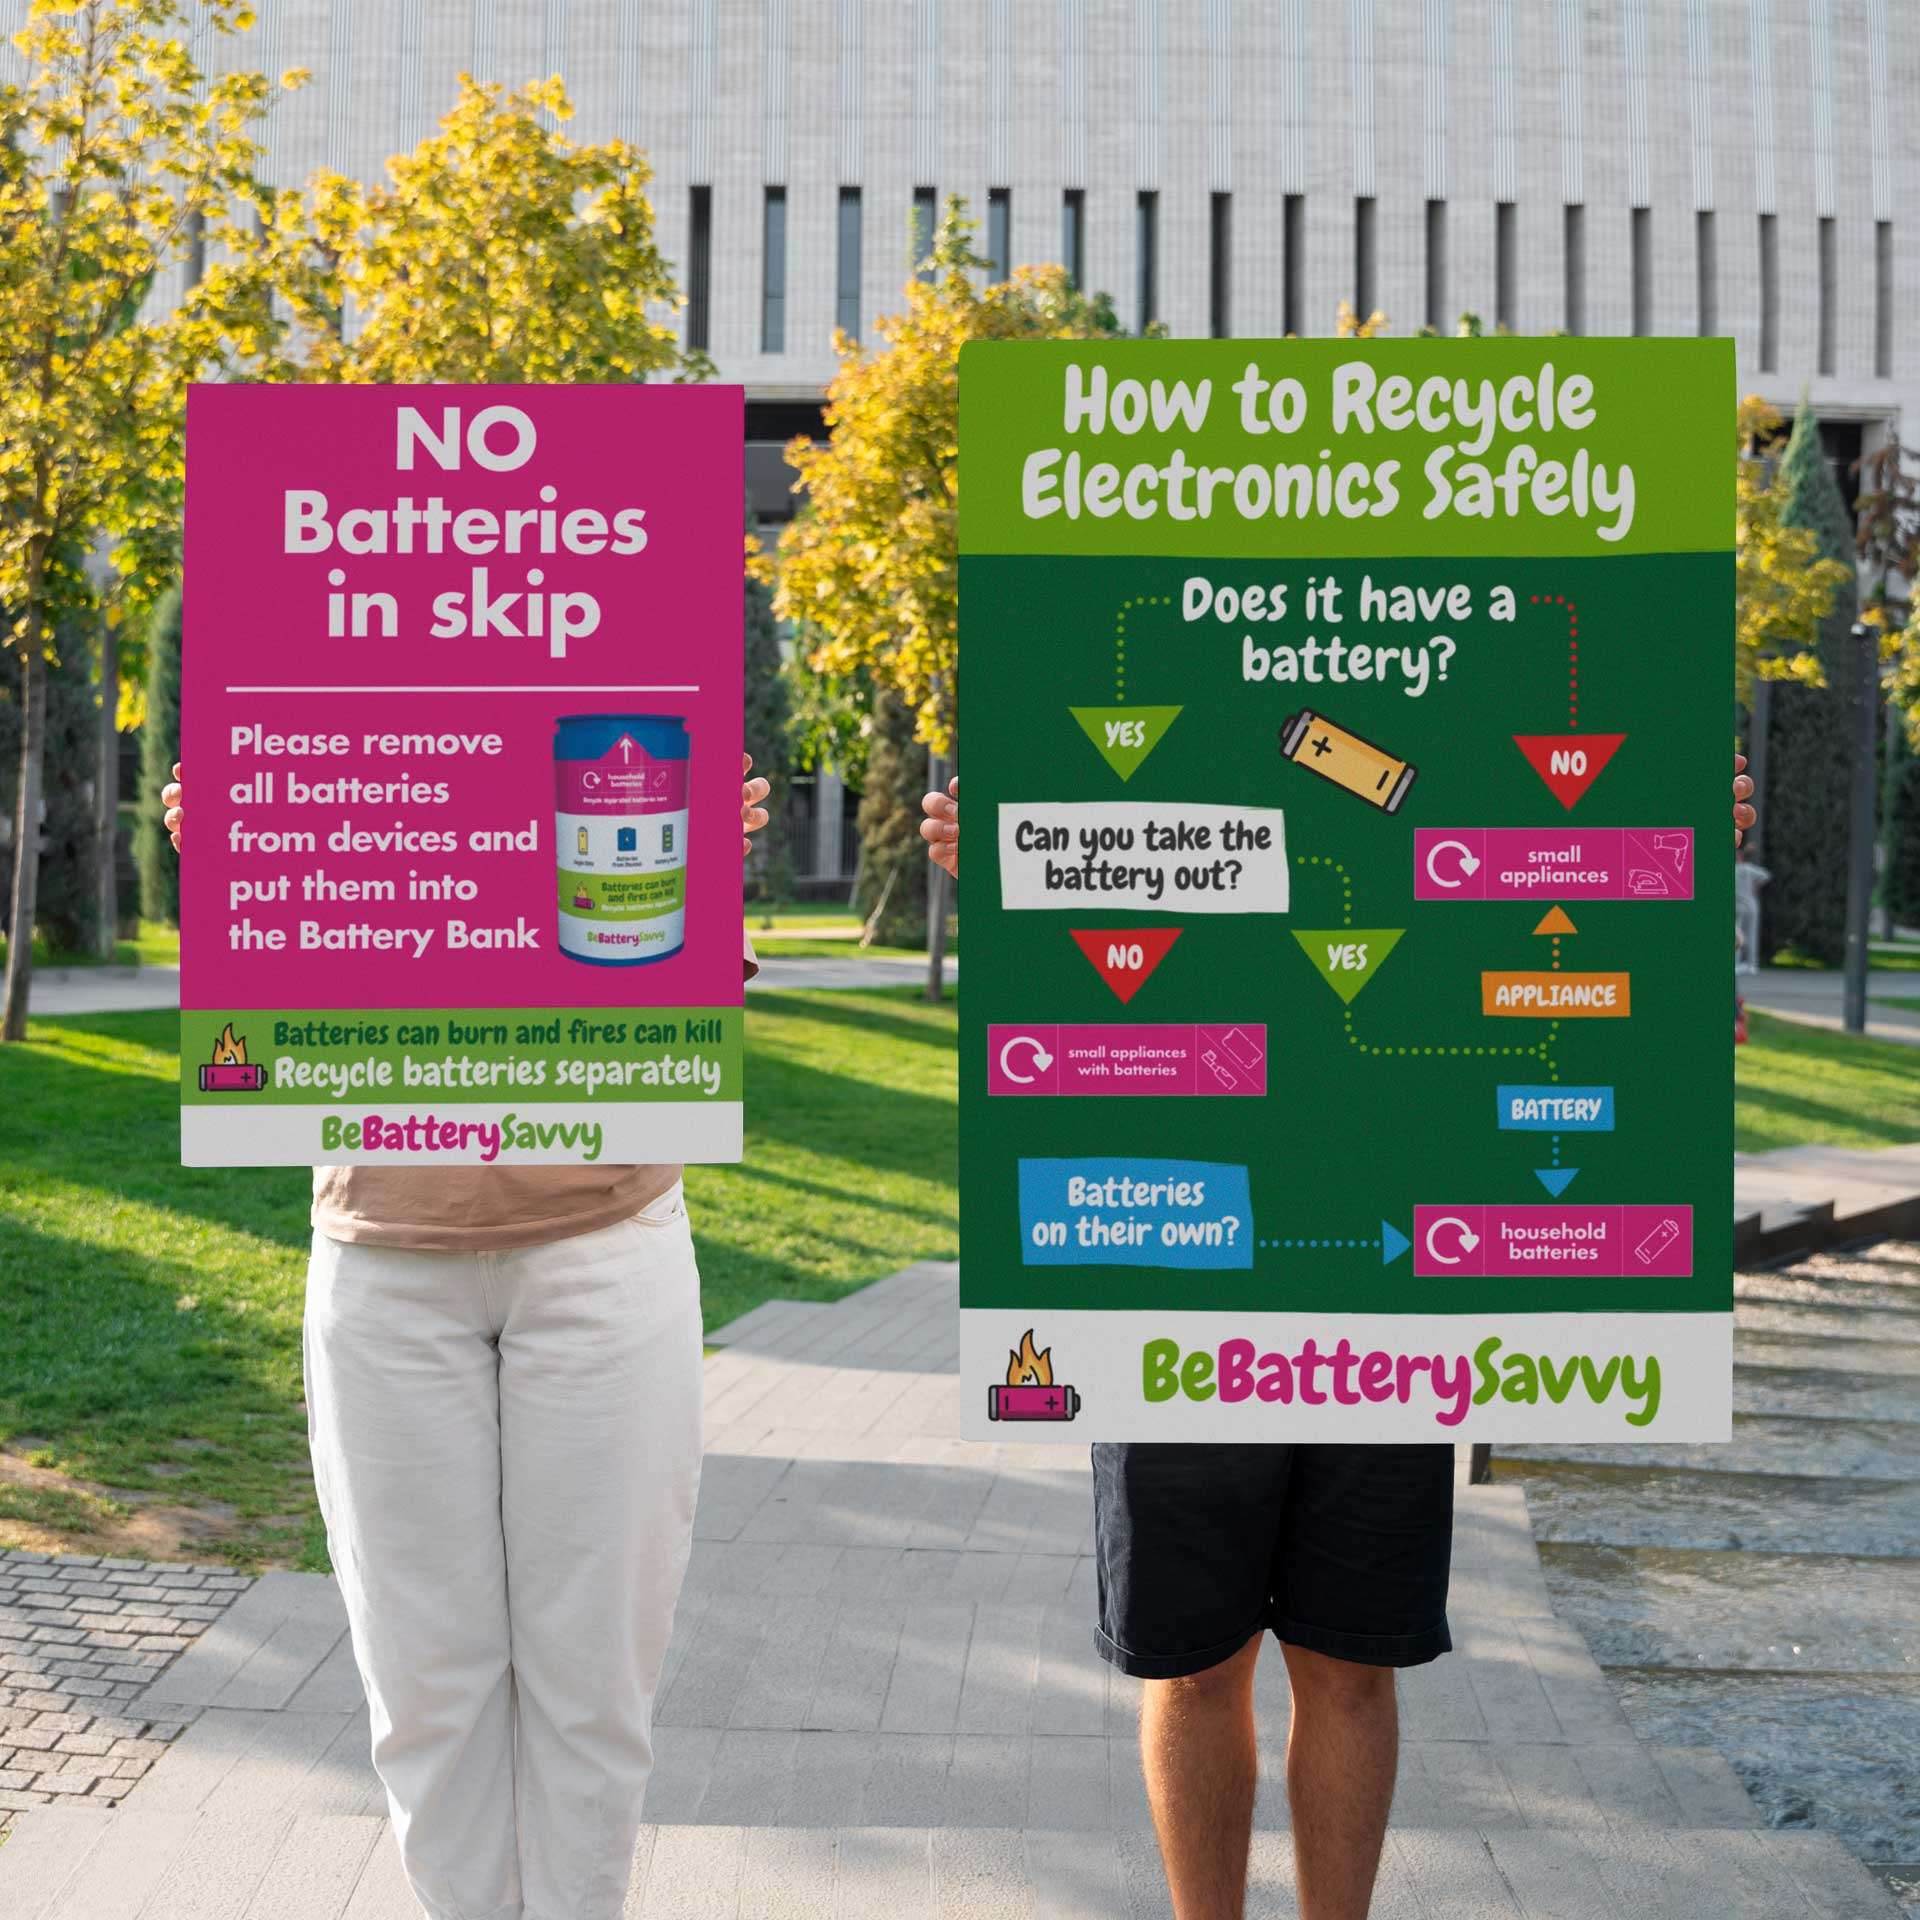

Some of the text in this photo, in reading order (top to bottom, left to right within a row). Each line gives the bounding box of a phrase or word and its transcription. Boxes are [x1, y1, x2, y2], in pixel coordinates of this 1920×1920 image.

[1064, 361, 1597, 455] How to Recycle
[397, 406, 536, 471] NO
[1022, 445, 1636, 542] Electronics Safely
[285, 486, 647, 554] Batteries
[328, 567, 600, 657] in skip
[1183, 575, 1515, 623] Does it have a
[1243, 635, 1456, 697] battery?
[232, 724, 502, 755] Please remove
[1105, 721, 1145, 747] YES
[1551, 751, 1586, 776] NO
[230, 772, 449, 803] all batteries
[229, 820, 537, 852] from devices and
[1016, 820, 1271, 860] Can you take the
[1528, 845, 1580, 863] small
[231, 870, 477, 910] put them into
[1045, 859, 1242, 901] battery out?
[1501, 865, 1608, 887] appliances
[229, 917, 539, 958] the Battery Bank
[586, 931, 665, 947] BeBatterySavvy
[1107, 944, 1143, 970] NO
[1328, 944, 1368, 971] YES
[1496, 985, 1616, 1007] APPLIANCE
[274, 1018, 721, 1046] Batteries can burn and fires can kill
[1069, 1046, 1186, 1061] small appliances
[1078, 1063, 1177, 1075] with batteries
[275, 1054, 720, 1097] Recycle batteries separately
[1512, 1098, 1601, 1121] BATTERY
[321, 1113, 603, 1163] BeBatterySavvy
[1069, 1176, 1204, 1207] Batteries
[1033, 1215, 1239, 1246] on their own?
[1502, 1222, 1605, 1240] household
[1510, 1242, 1598, 1259] batteries
[1142, 1336, 1662, 1428] BeBatterySavvy
